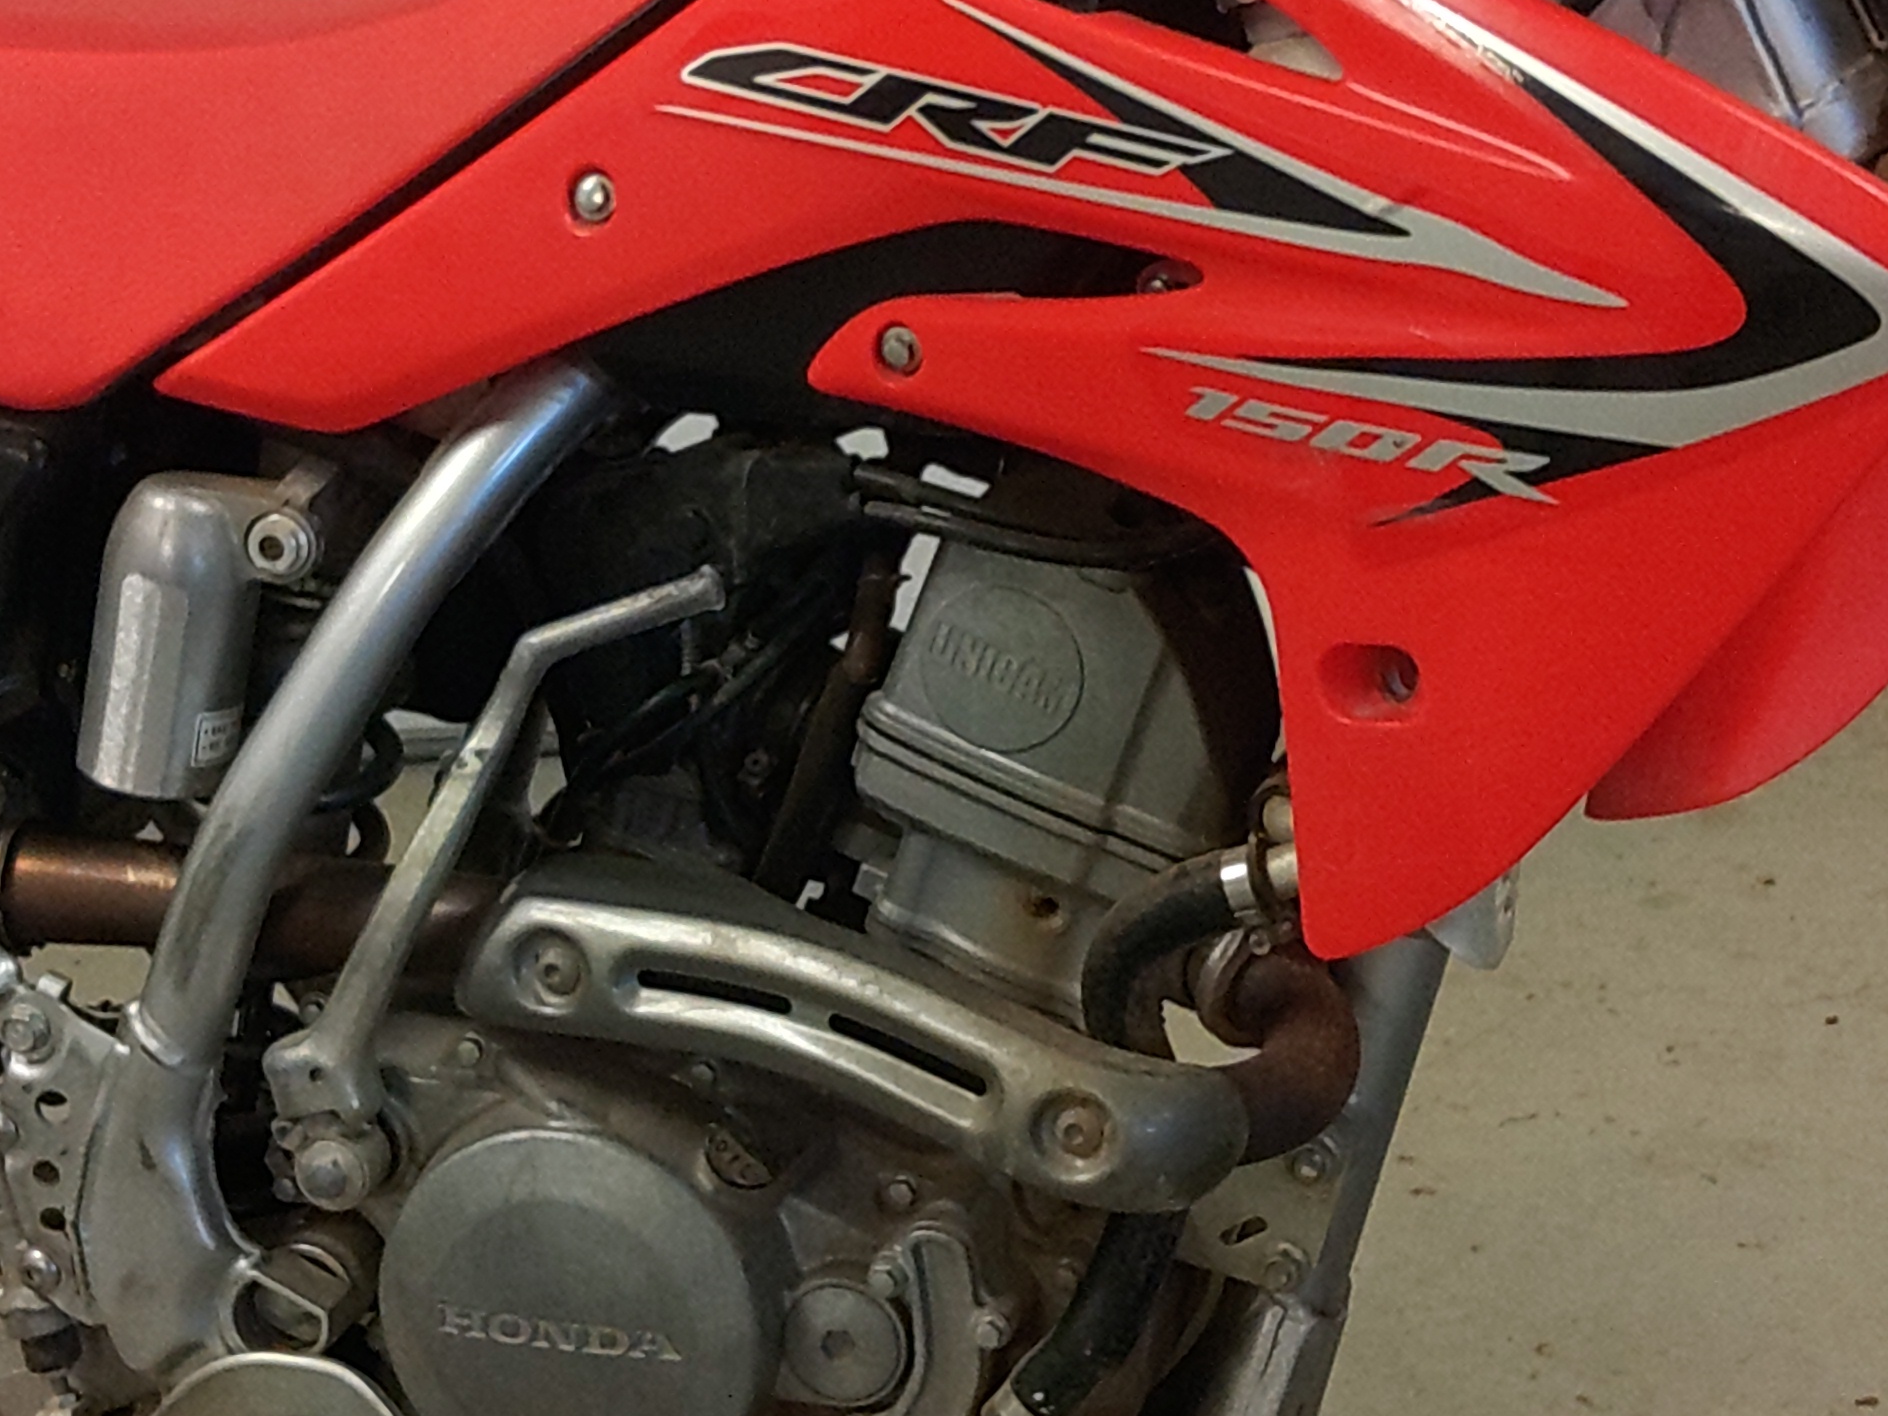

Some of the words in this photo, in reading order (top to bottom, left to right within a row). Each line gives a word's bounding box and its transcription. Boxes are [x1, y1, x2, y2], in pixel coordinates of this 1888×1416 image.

[682, 43, 1233, 176] CRF
[1184, 387, 1559, 504] 150R
[437, 1302, 682, 1361] HONDA
